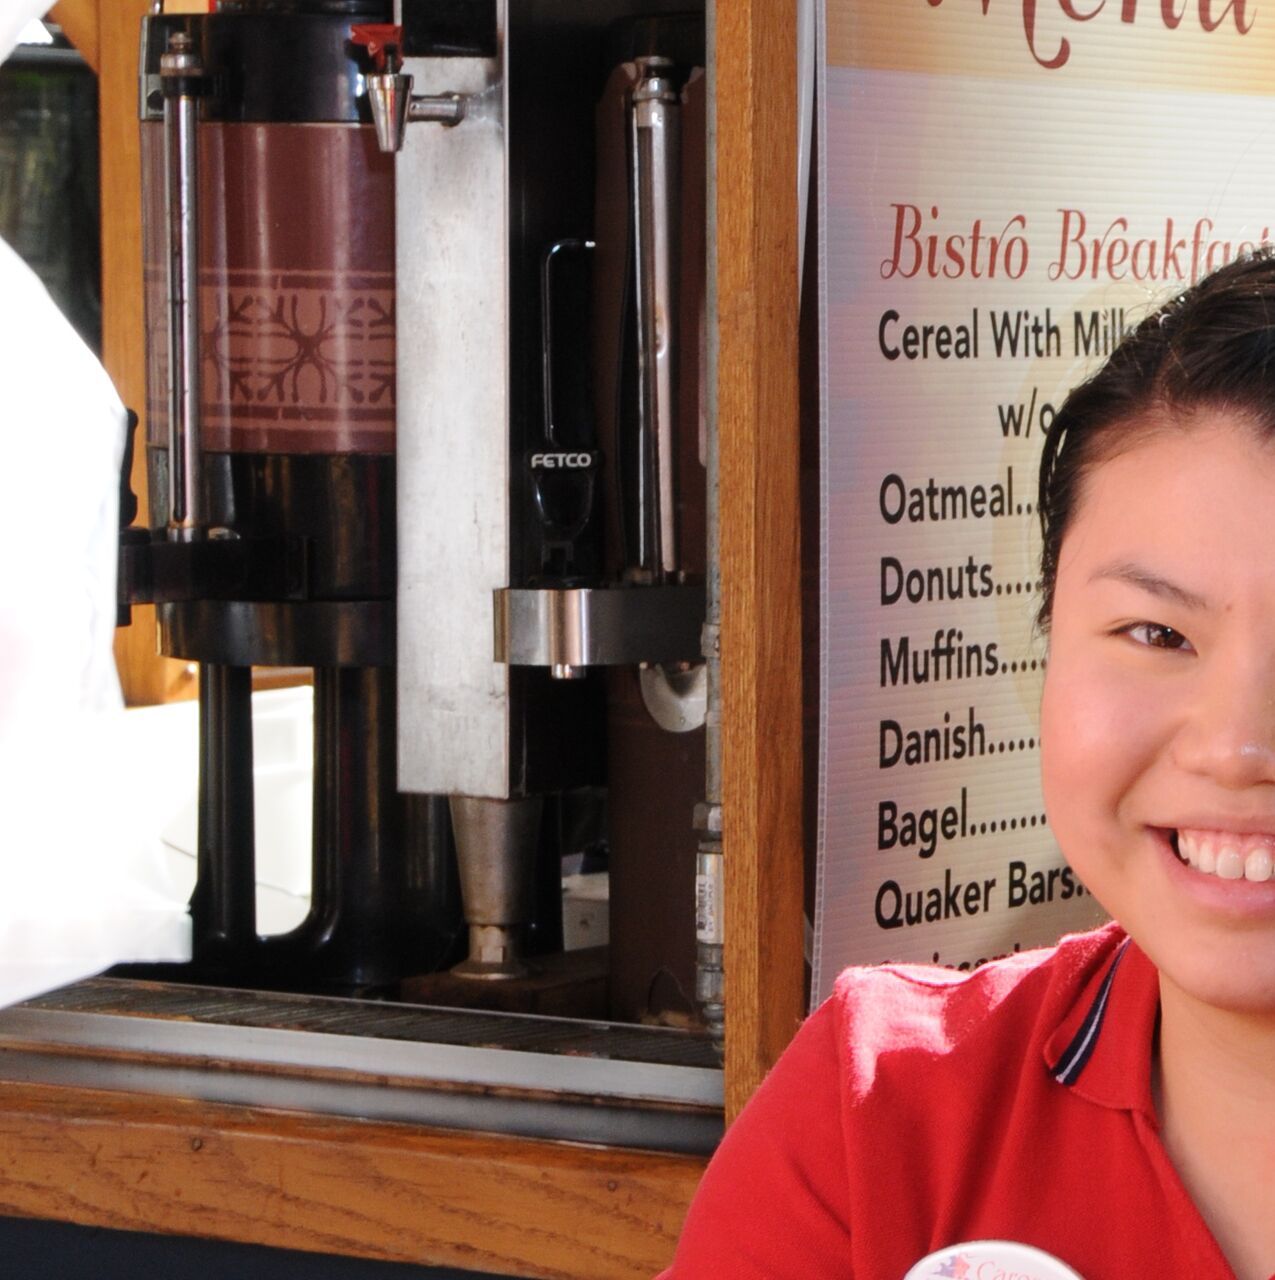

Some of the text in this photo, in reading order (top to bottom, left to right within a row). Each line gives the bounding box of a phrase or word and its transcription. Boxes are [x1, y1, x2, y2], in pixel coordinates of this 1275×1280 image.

[879, 203, 1030, 281] Bistro
[878, 307, 980, 361] Cereal
[990, 307, 1062, 358] With
[531, 453, 592, 469] FETCO
[874, 869, 997, 930] Quaker
